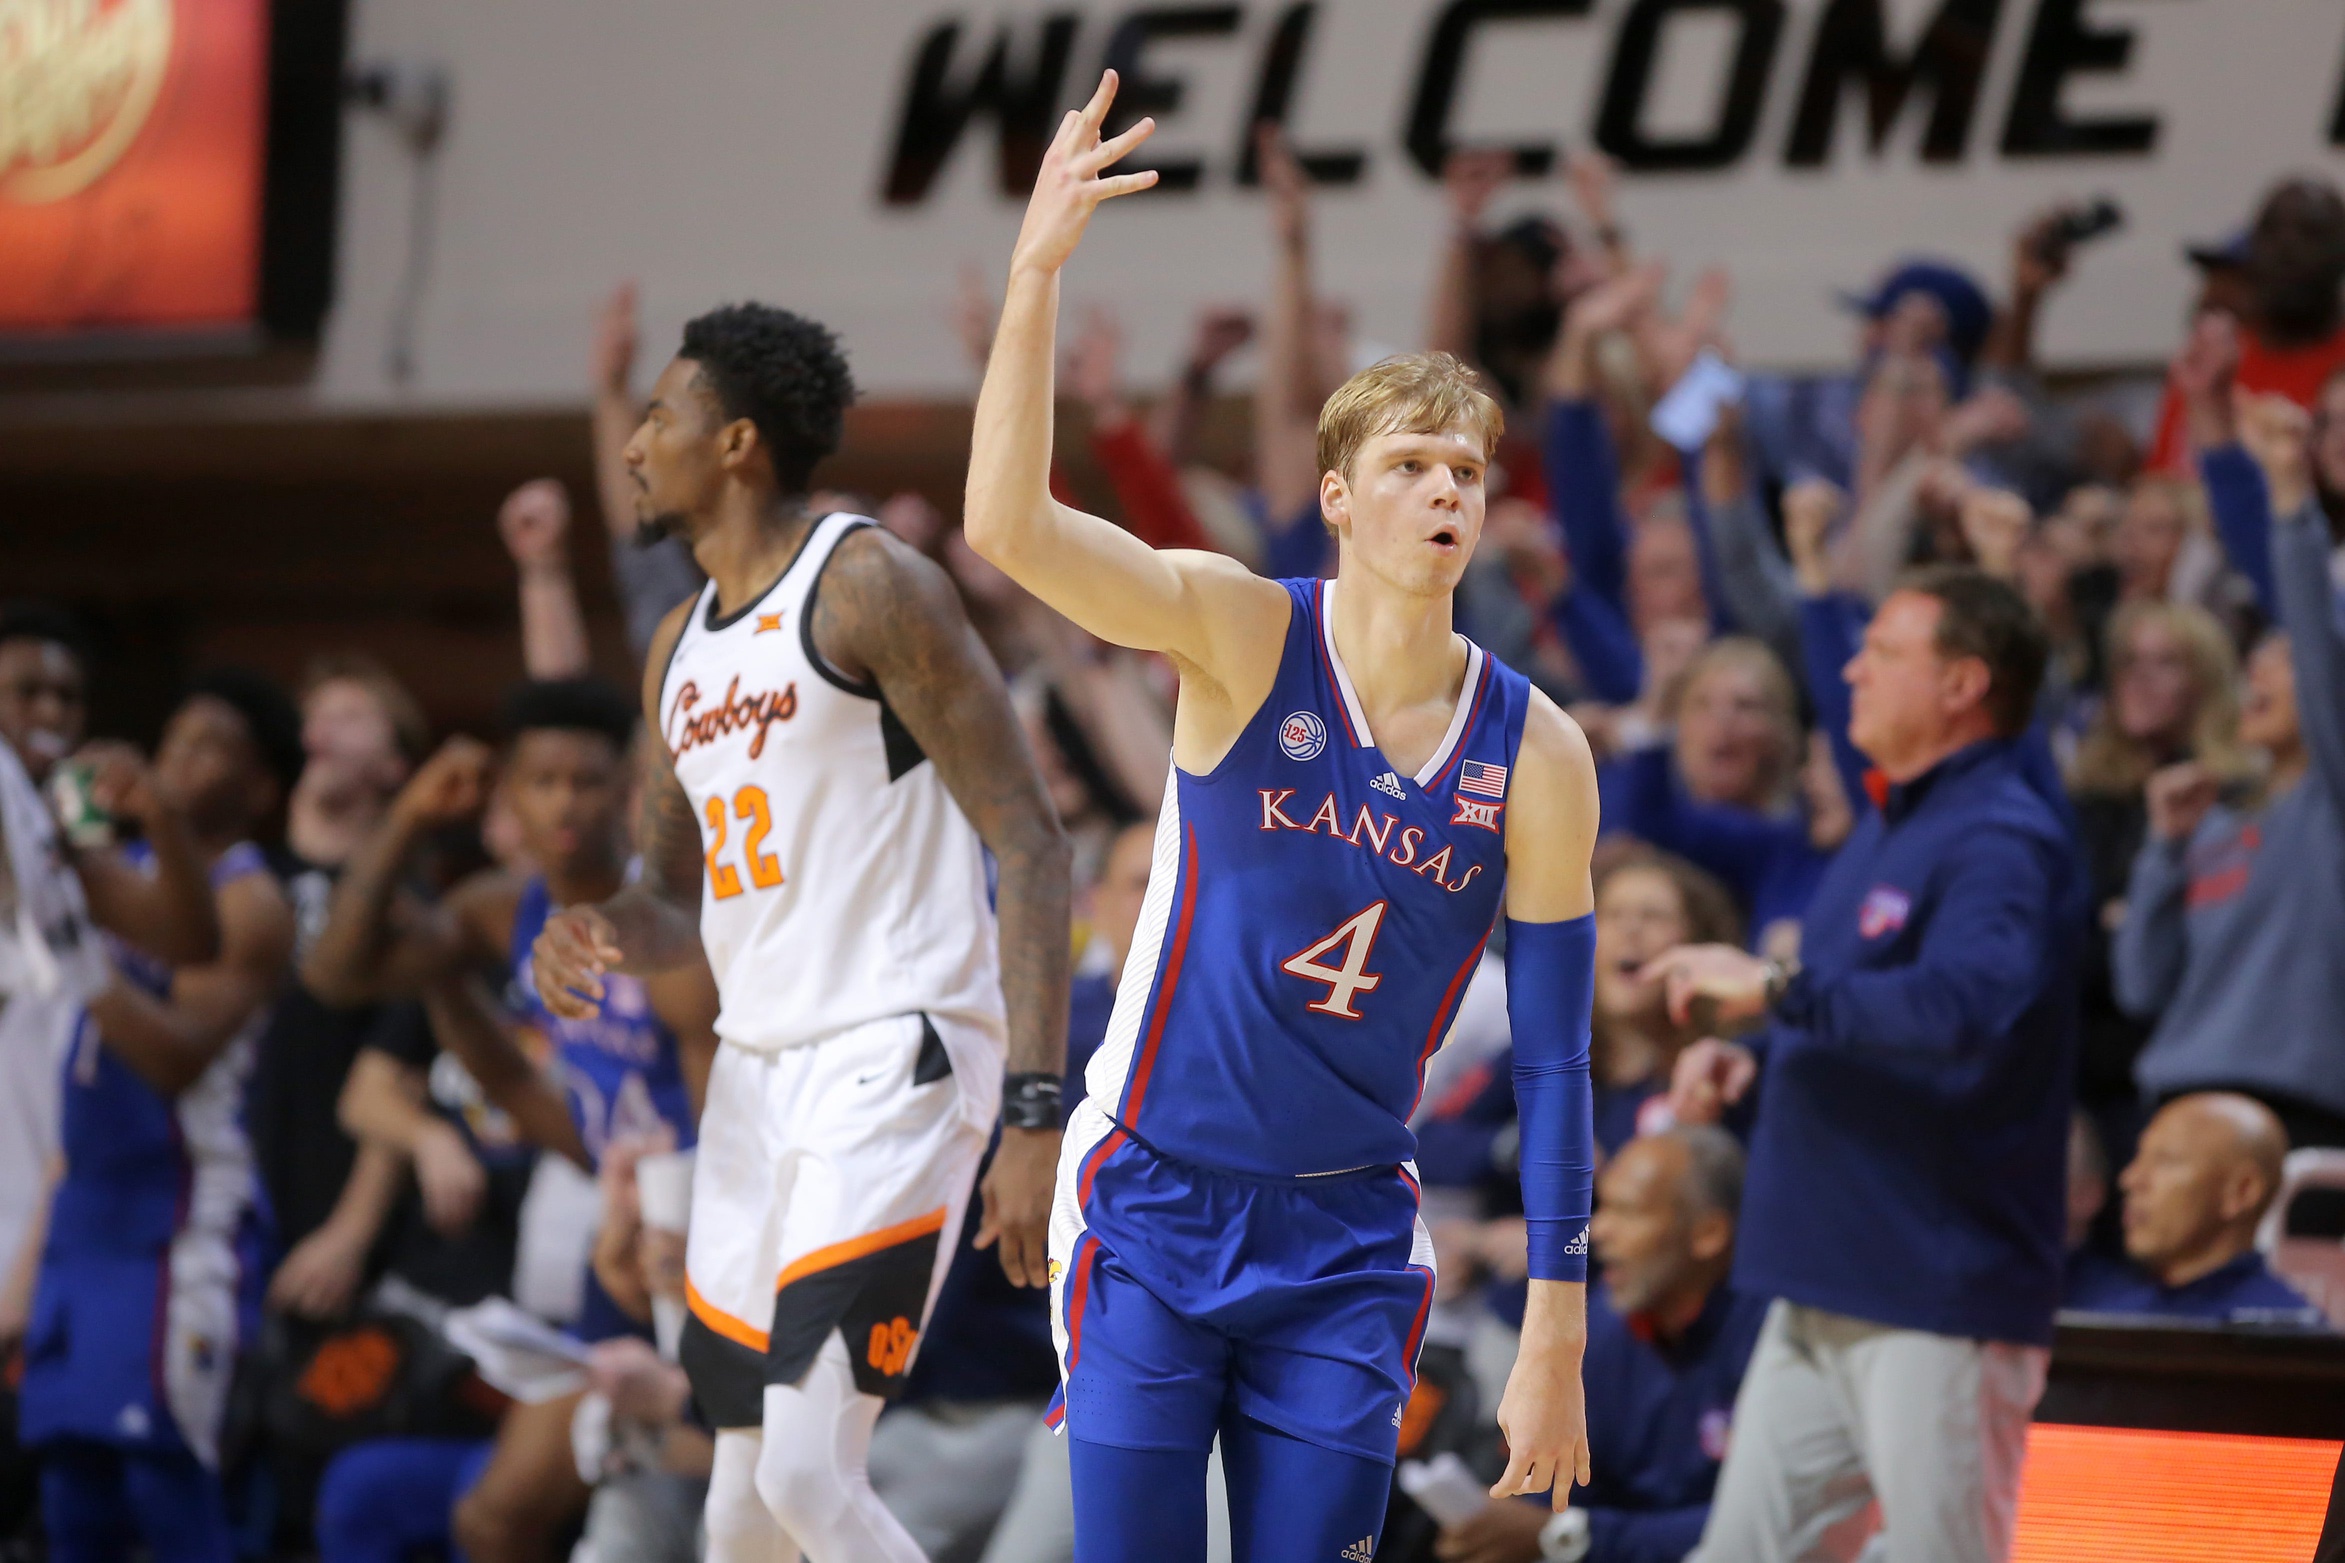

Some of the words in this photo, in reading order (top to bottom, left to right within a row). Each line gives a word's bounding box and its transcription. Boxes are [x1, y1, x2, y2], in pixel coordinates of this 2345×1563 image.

[882, 0, 2162, 206] WELCOME
[667, 674, 797, 767] Cowboys
[1284, 724, 1308, 743] 125
[1369, 777, 1407, 801] adidas
[705, 785, 784, 900] 22
[1258, 788, 1483, 893] KANSAS
[1280, 899, 1389, 1021] 4
[1564, 1243, 1588, 1255] adid
